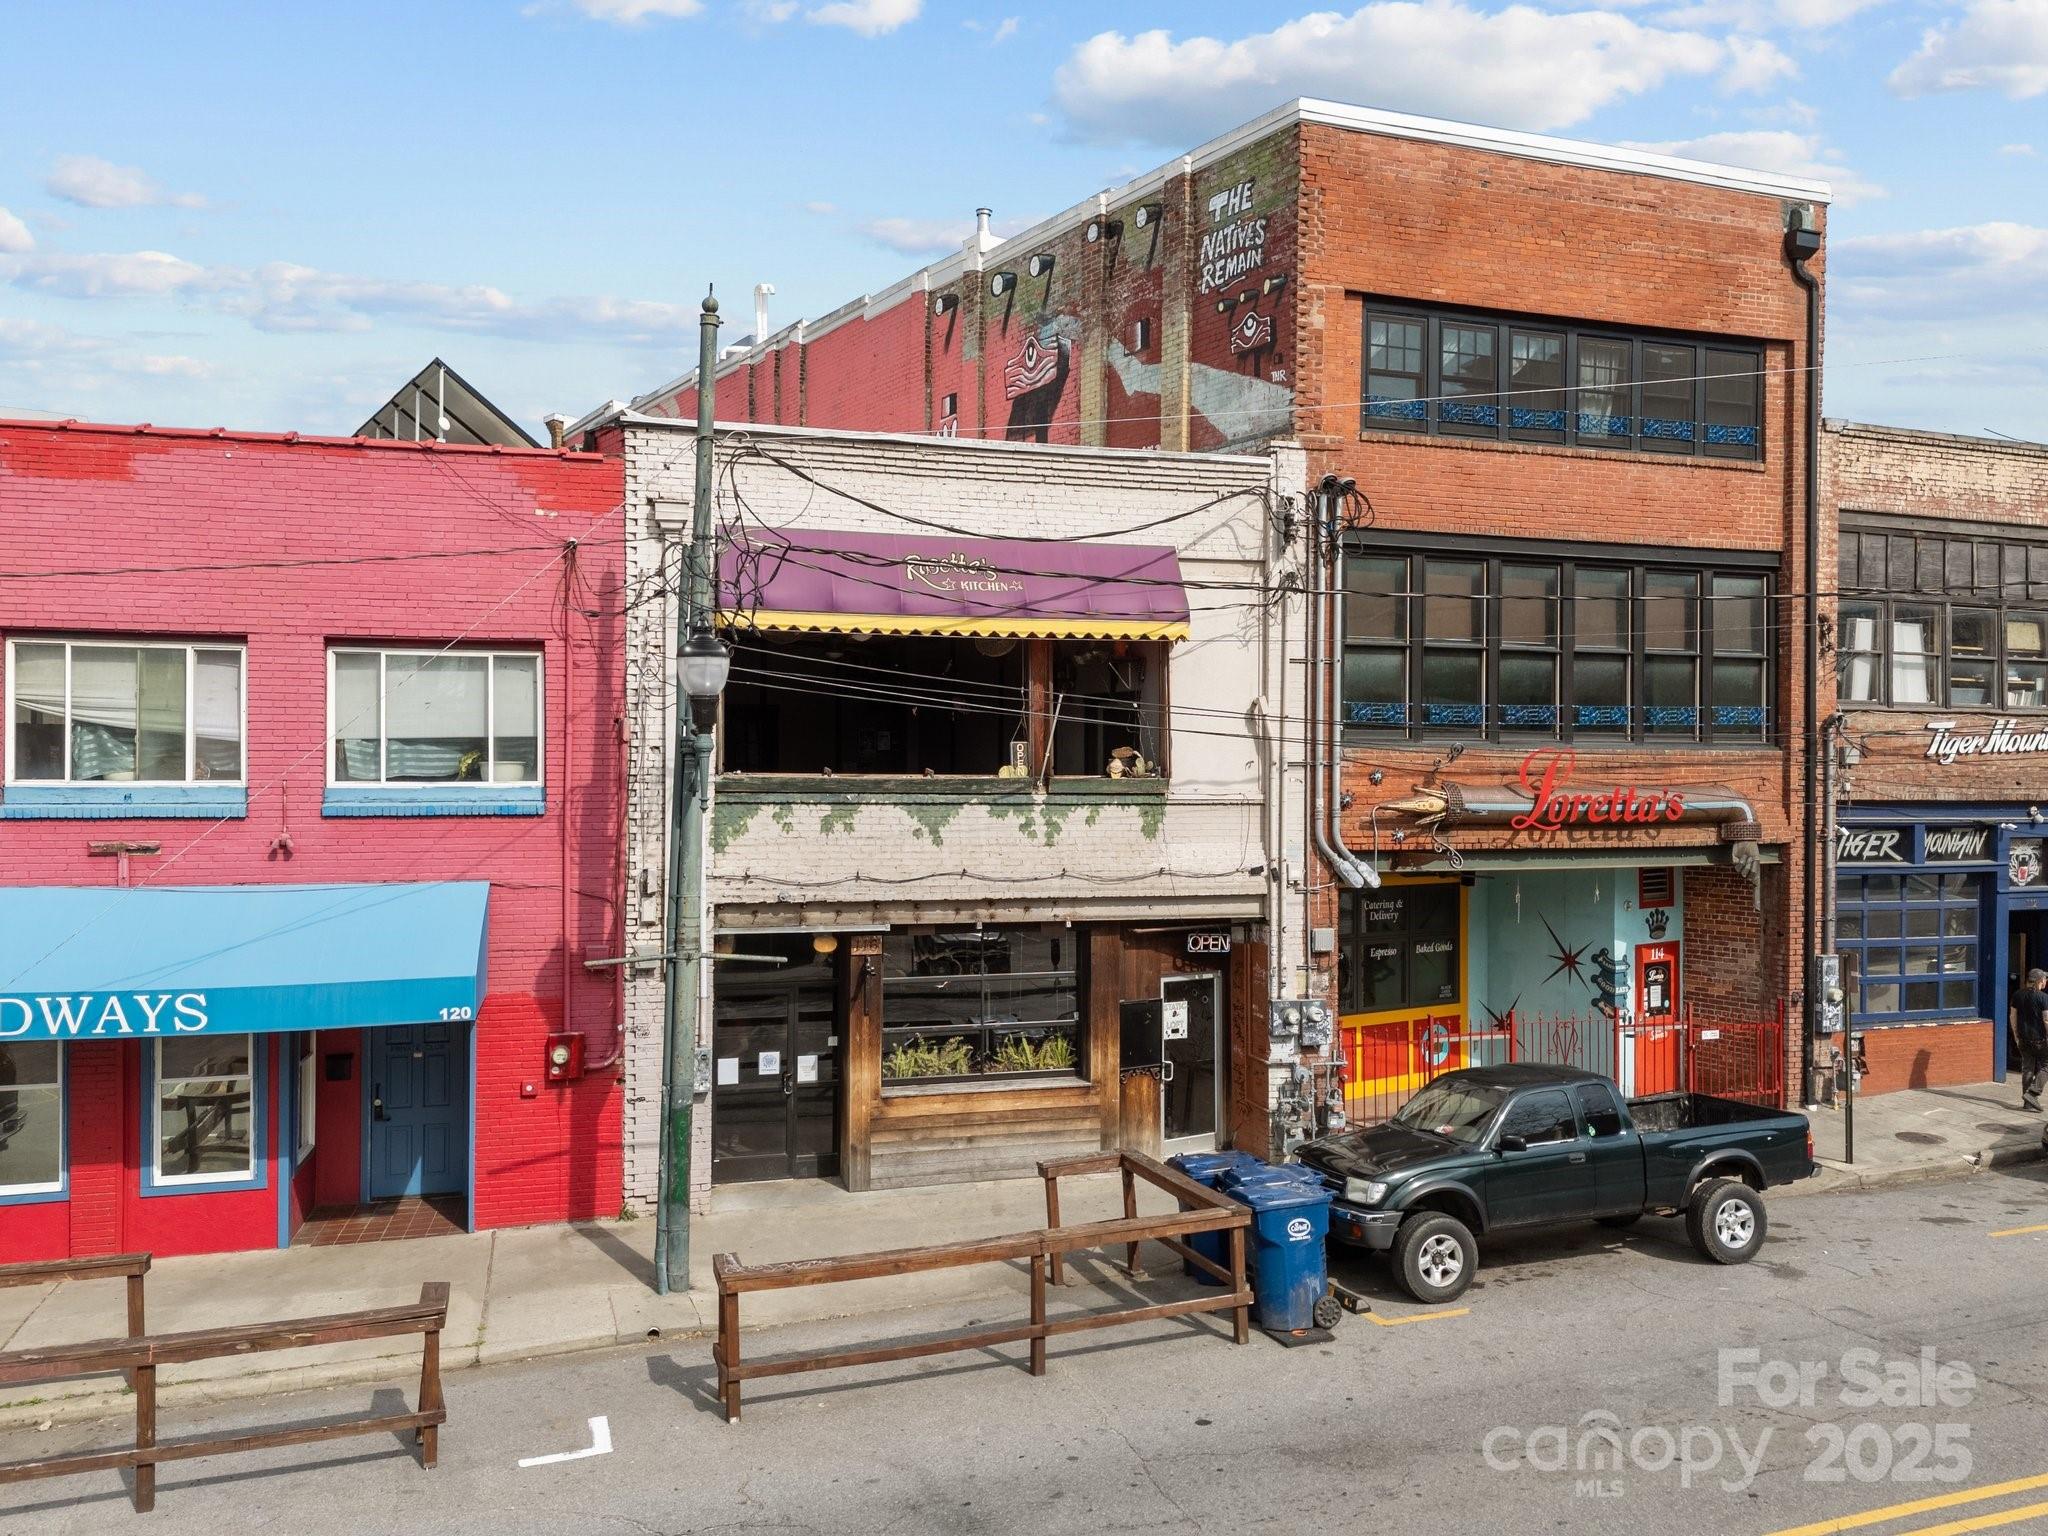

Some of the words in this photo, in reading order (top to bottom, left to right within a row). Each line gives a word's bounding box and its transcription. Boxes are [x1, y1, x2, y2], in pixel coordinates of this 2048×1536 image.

[1208, 182, 1253, 223] THE
[1201, 247, 1262, 295] REMAIN
[960, 580, 1009, 592] KITCHEN
[1925, 720, 1986, 765] Tiger
[1980, 718, 2048, 754] Moun
[1015, 743, 1025, 777] OPEN
[1510, 746, 1685, 831] Loretta's
[1364, 901, 1395, 912] Catering
[1395, 900, 1404, 908] &
[1369, 912, 1400, 923] Delivery
[1189, 935, 1230, 951] OPEN
[1415, 943, 1434, 954] Baked
[1434, 941, 1453, 953] Goods
[1370, 948, 1397, 961] Espresso
[1650, 947, 1665, 960] 114
[439, 1006, 472, 1021] 120
